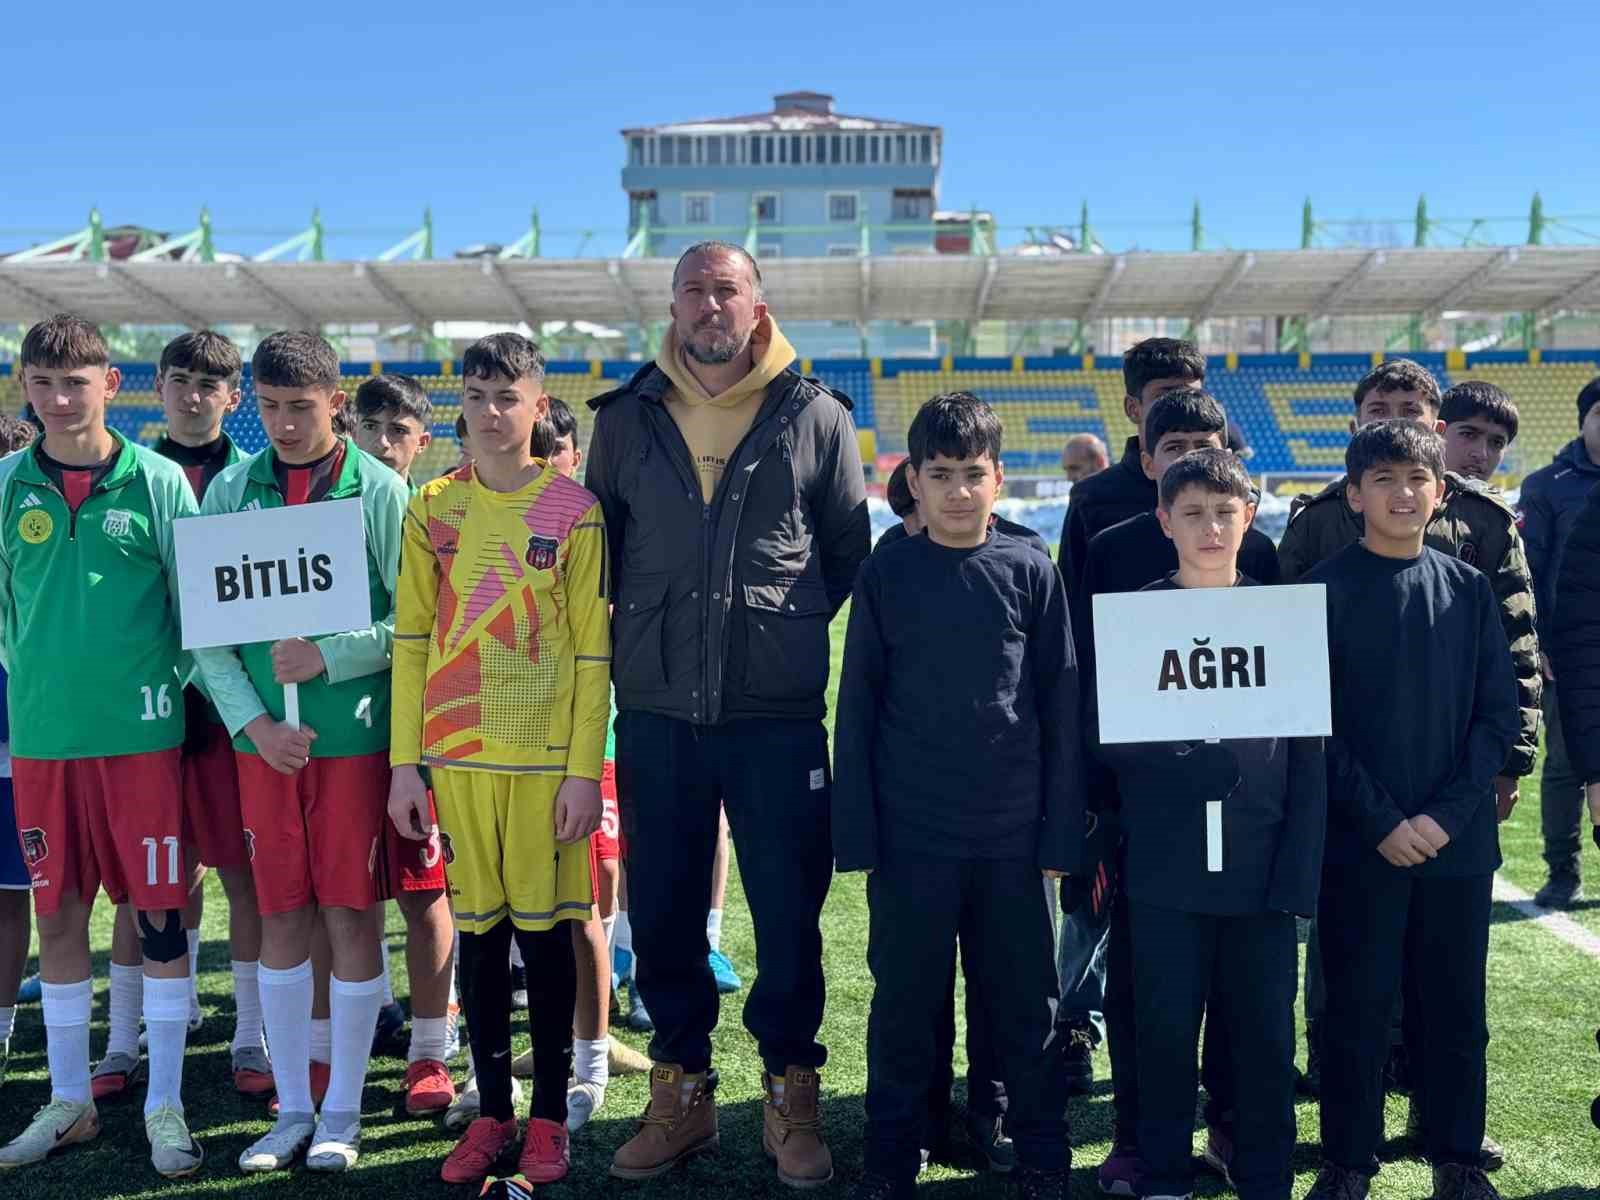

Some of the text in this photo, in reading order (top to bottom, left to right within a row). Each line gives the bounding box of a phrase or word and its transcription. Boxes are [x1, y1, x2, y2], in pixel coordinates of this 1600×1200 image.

[215, 547, 333, 602] BİTLİS
[1158, 637, 1266, 691] AĞRI
[141, 684, 172, 720] 16
[142, 836, 179, 886] 11
[656, 1069, 673, 1081] CAT
